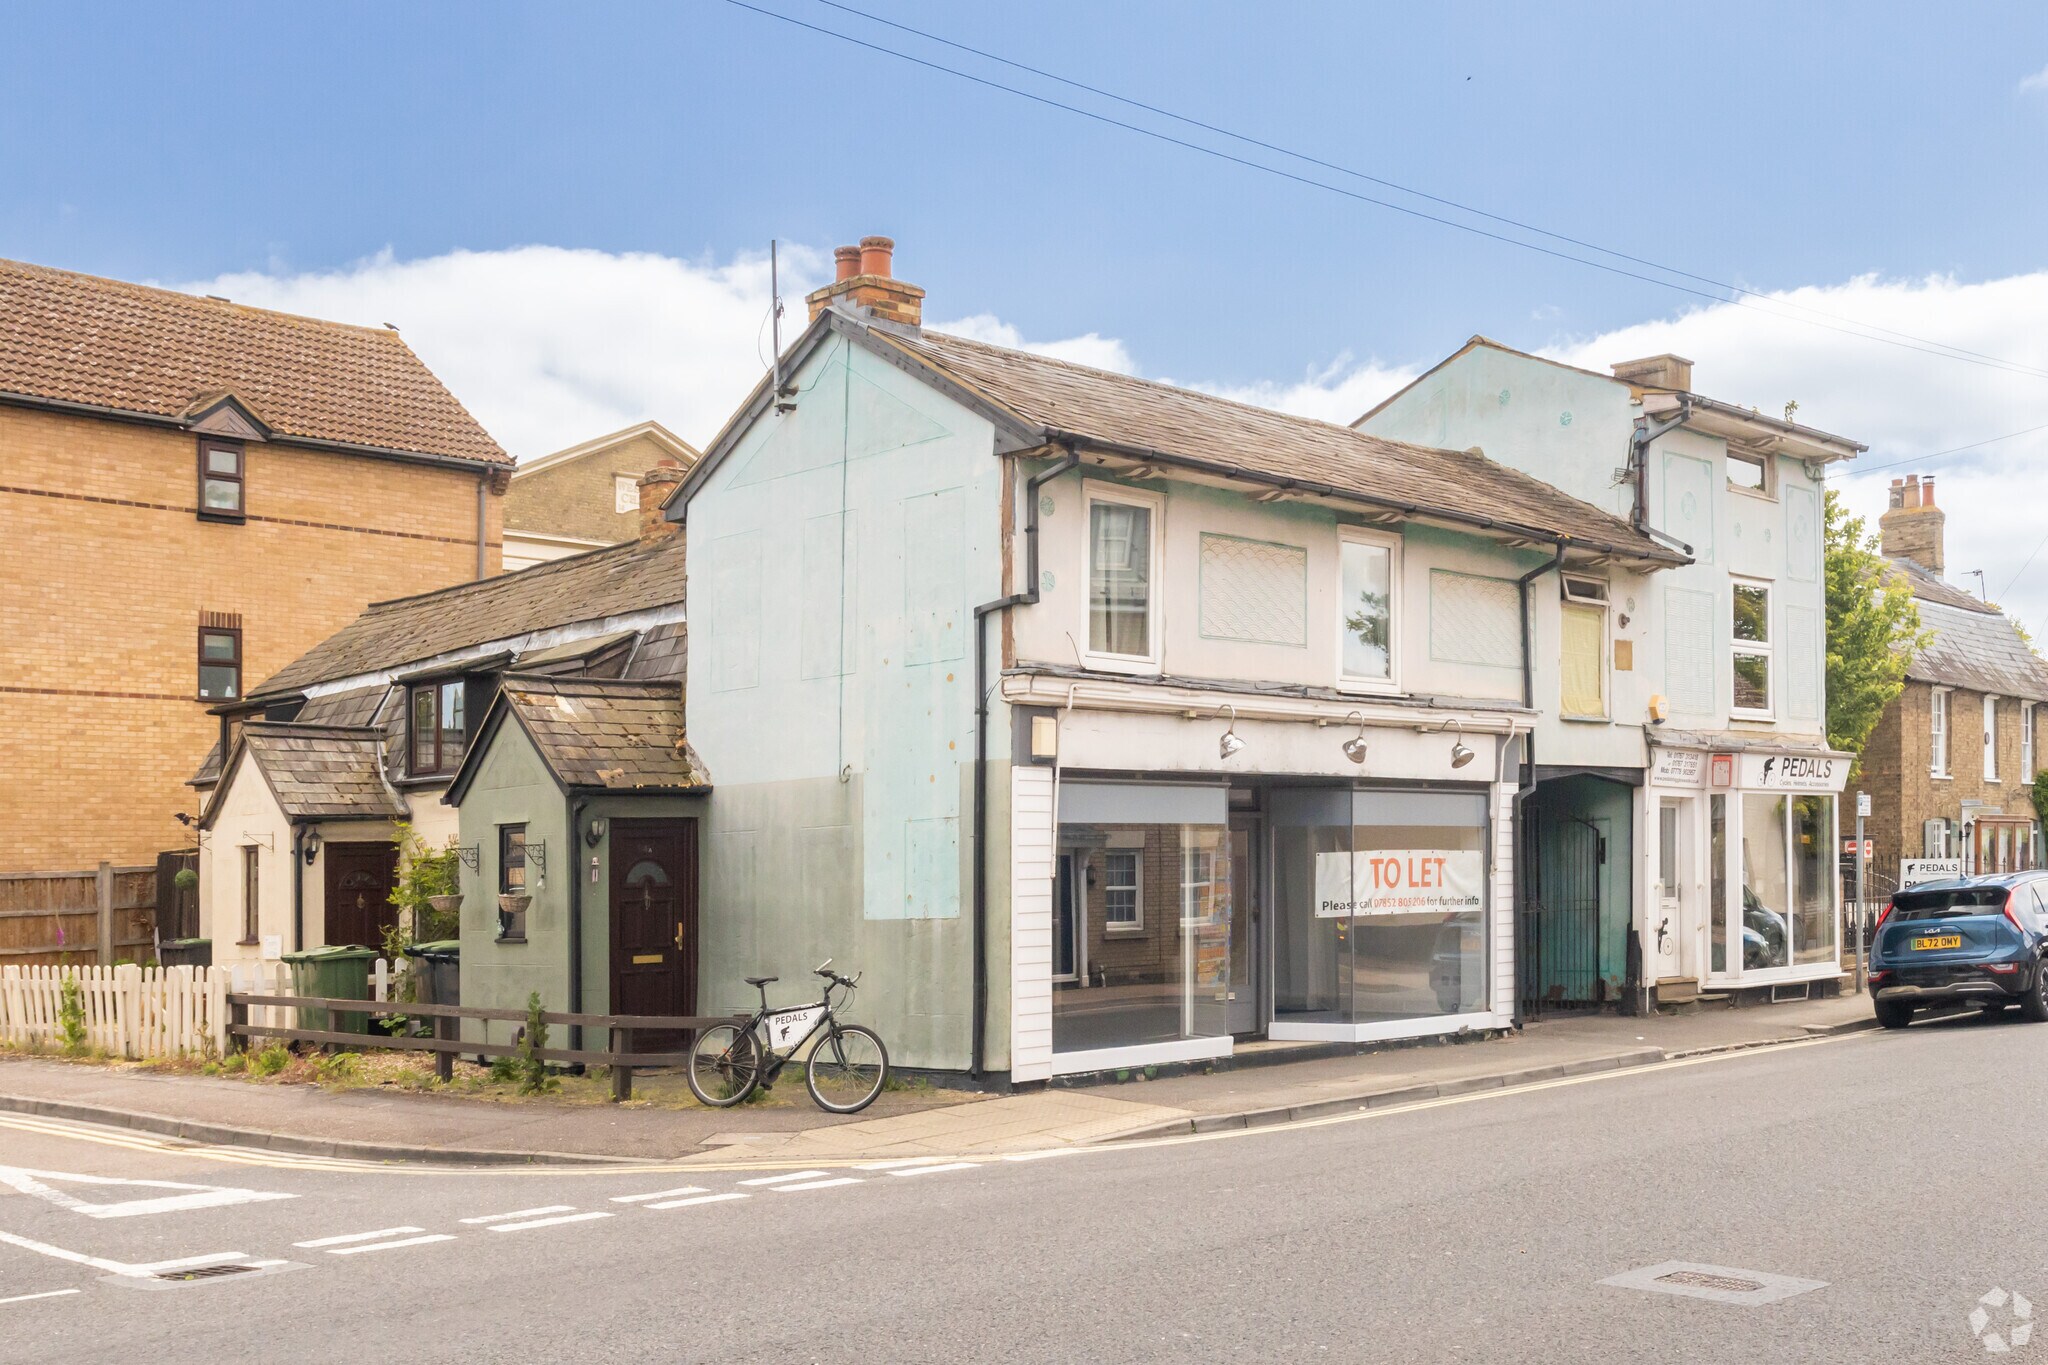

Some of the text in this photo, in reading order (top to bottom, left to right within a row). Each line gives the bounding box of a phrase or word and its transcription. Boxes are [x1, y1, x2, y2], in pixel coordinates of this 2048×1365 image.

[1781, 757, 1833, 779] PEDALS
[1370, 857, 1446, 889] TO LET
[1920, 864, 1958, 872] PEDALS
[1322, 900, 1357, 911] Please
[1360, 898, 1373, 909] call
[1374, 897, 1396, 908] 07852
[1427, 896, 1438, 906] for
[1440, 896, 1464, 906] further
[1465, 895, 1479, 906] info
[1916, 937, 1959, 949] BL72 OMY
[775, 1012, 808, 1026] PEDALS
